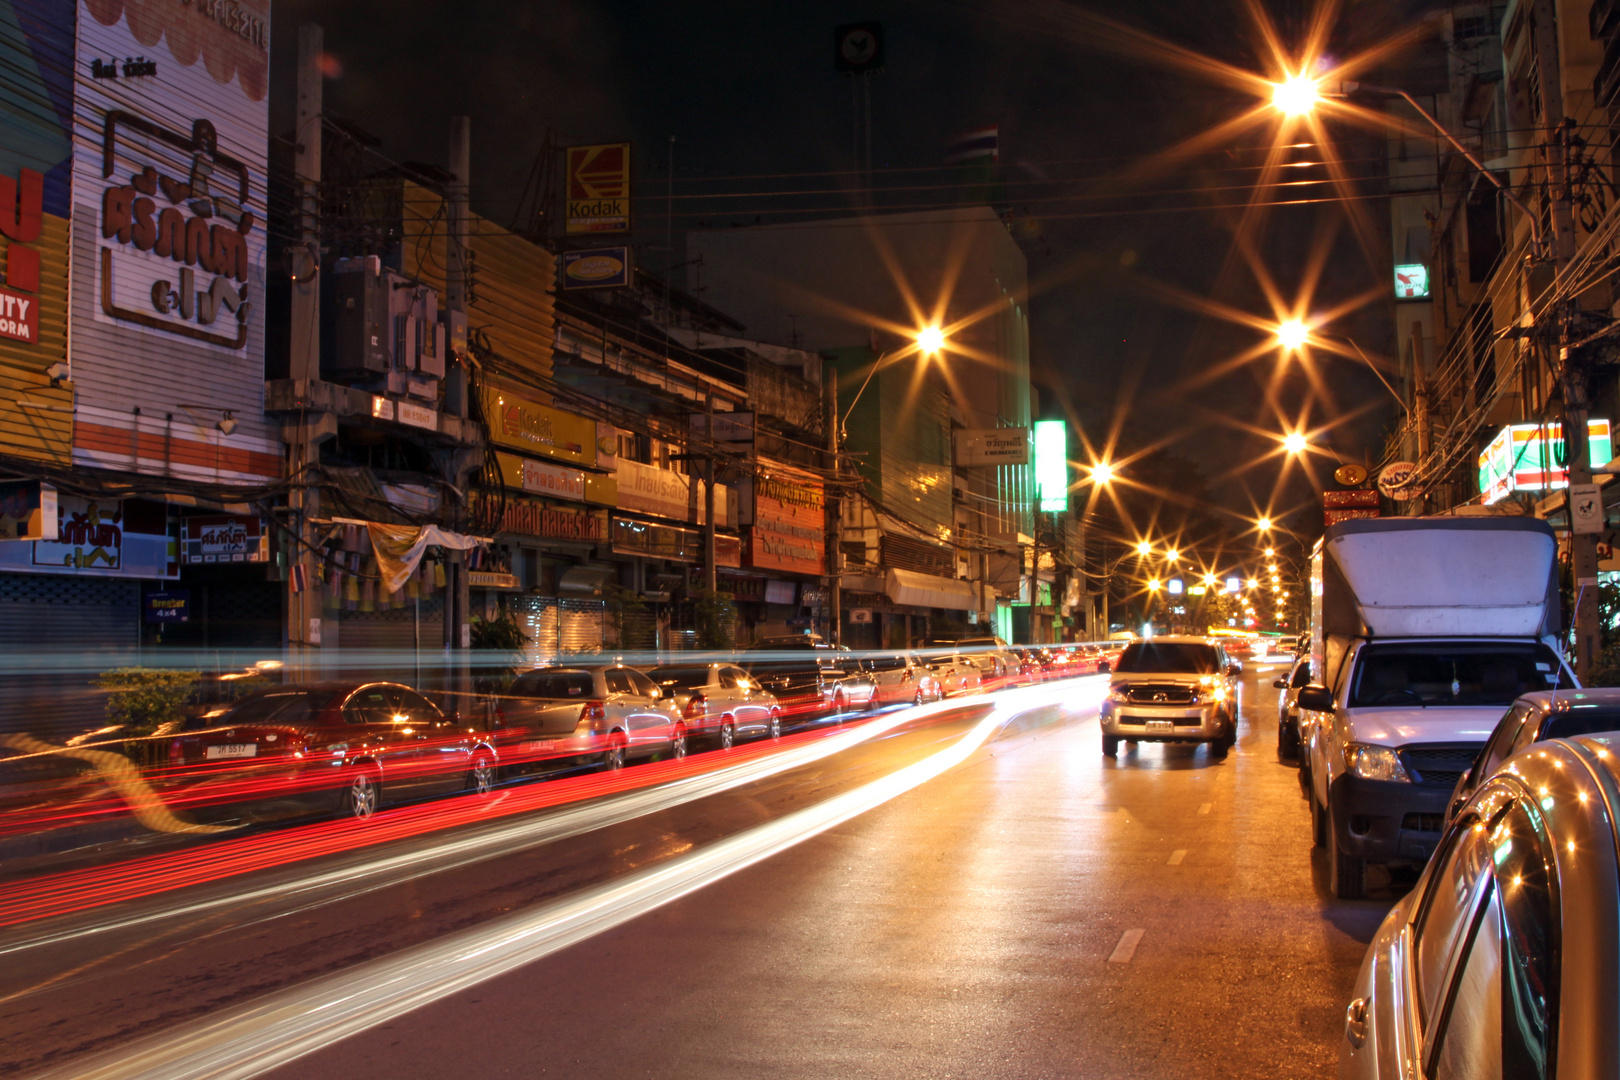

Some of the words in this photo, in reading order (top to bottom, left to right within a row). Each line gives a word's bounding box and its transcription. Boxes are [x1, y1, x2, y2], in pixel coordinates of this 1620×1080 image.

[570, 200, 621, 218] Kodak
[520, 408, 552, 437] Kodak
[156, 608, 177, 617] 4x4
[228, 744, 247, 753] 5517
